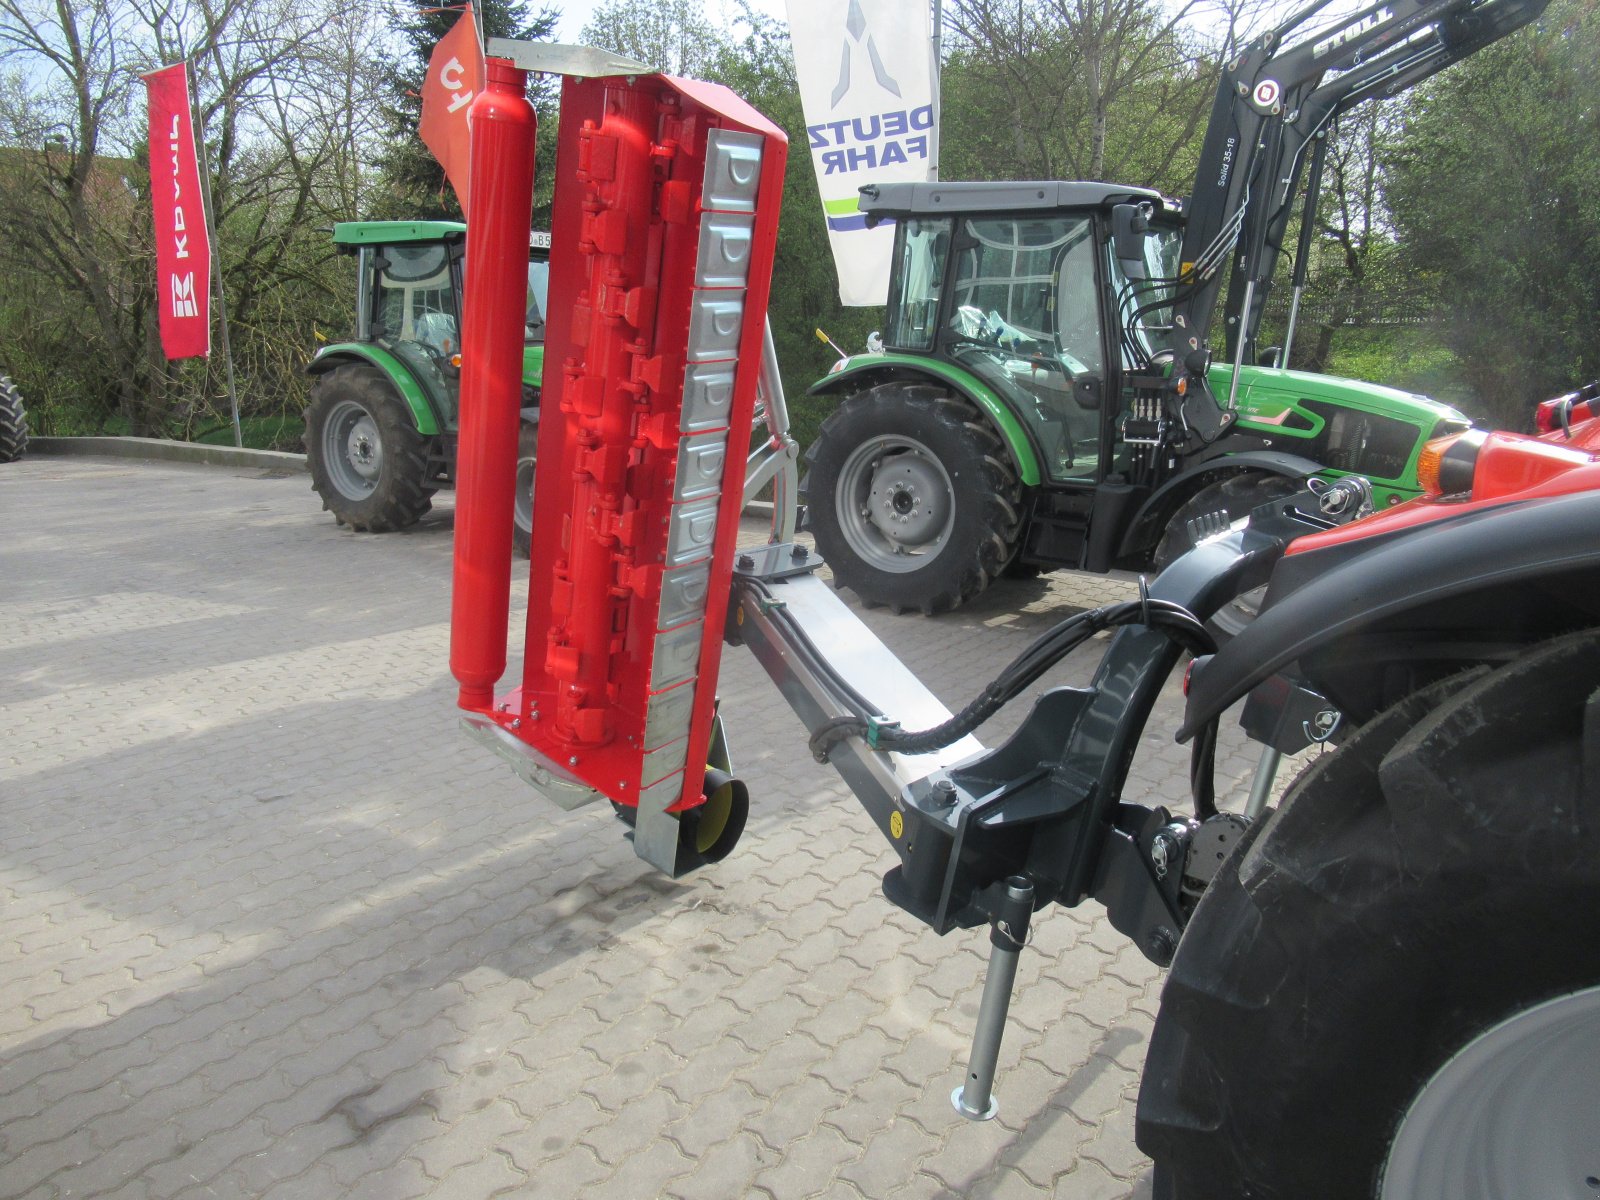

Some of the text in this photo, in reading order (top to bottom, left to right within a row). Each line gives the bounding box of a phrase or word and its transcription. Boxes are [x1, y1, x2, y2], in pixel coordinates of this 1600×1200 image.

[1313, 6, 1393, 60] STOLL
[1217, 137, 1235, 187] Solid 35-18
